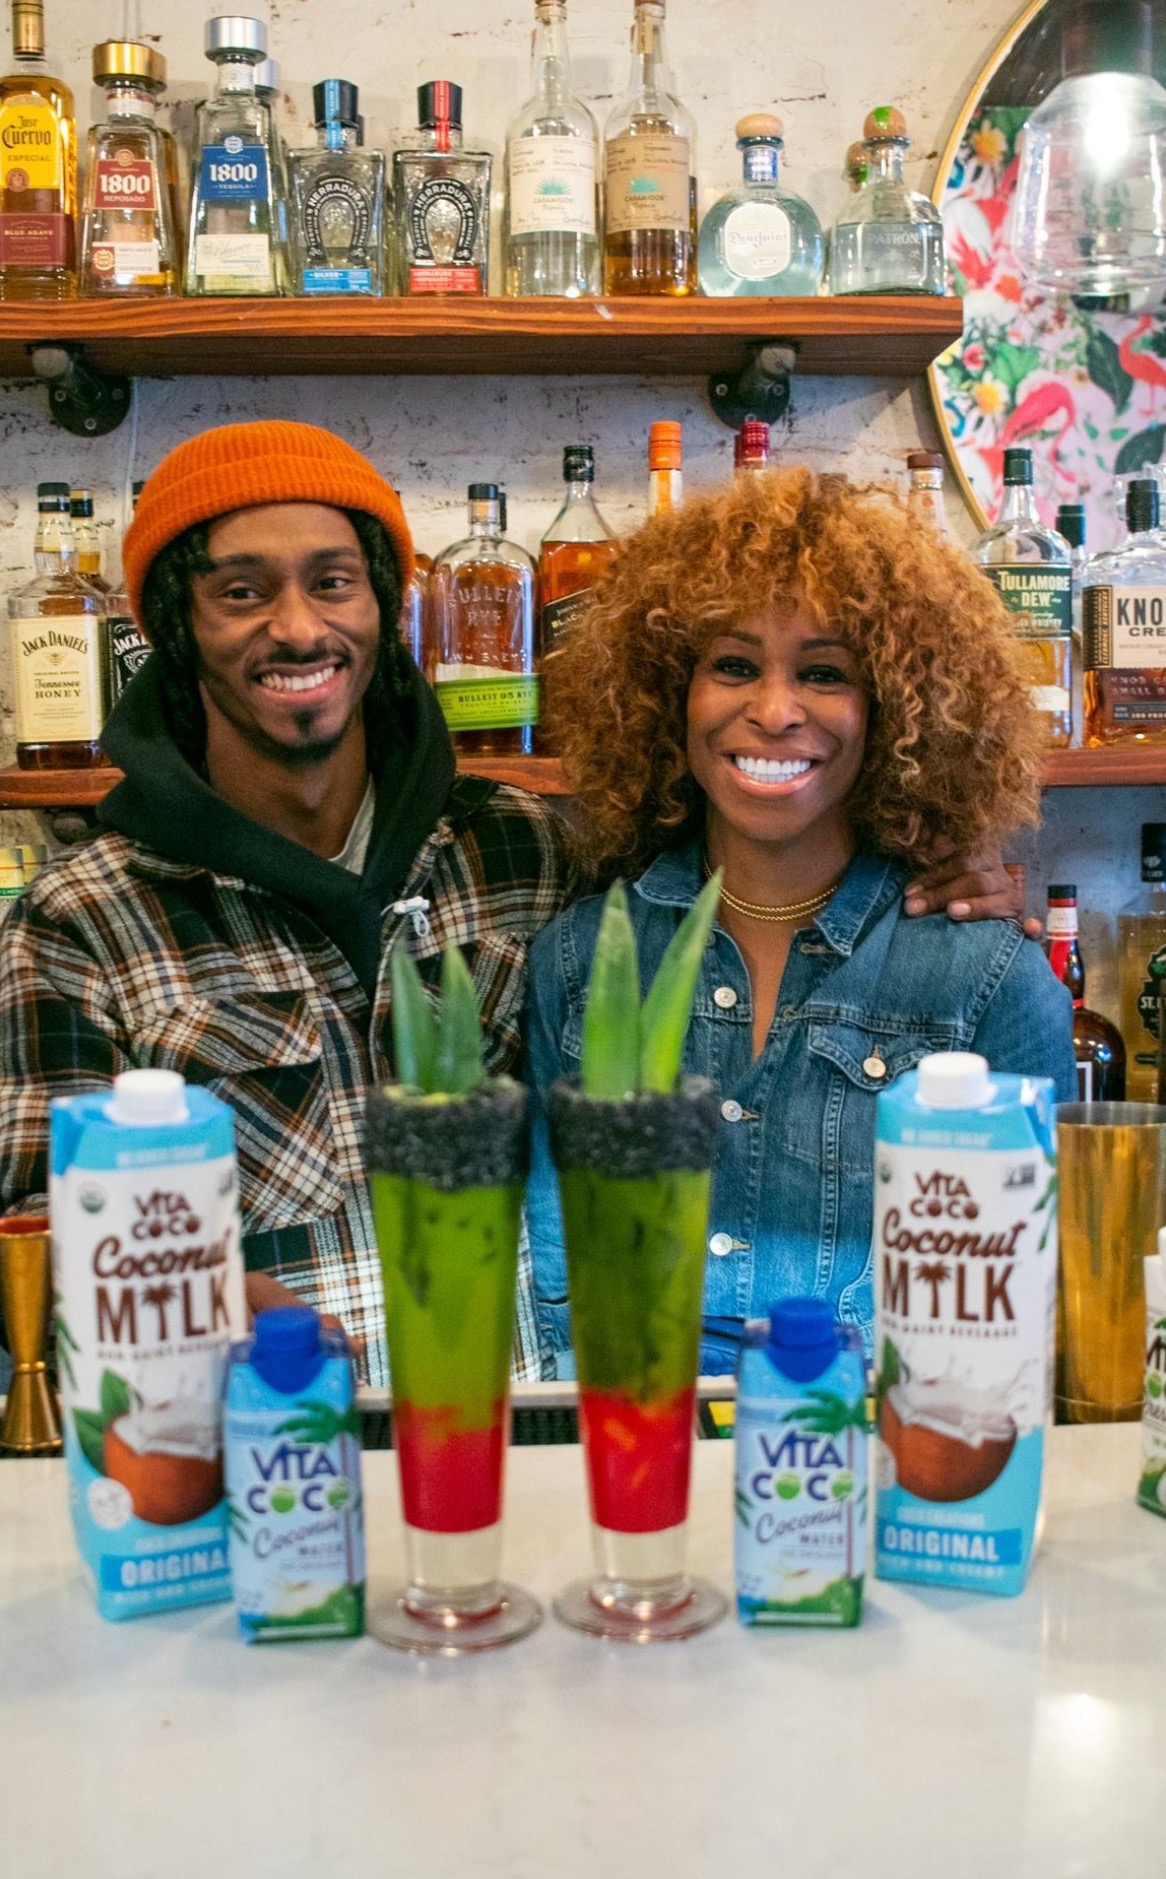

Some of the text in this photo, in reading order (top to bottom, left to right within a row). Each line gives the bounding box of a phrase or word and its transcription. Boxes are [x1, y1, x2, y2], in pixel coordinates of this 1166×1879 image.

[2, 124, 51, 149] Cuervo
[99, 174, 151, 194] 1800
[209, 163, 258, 182] 1800
[103, 195, 147, 203] REPOSADO
[307, 182, 366, 208] HERRADURA
[415, 183, 473, 211] HERRADURA
[997, 571, 1071, 592] TULLAMORE
[1021, 592, 1051, 607] DEW
[1117, 598, 1163, 626] KNO
[22, 630, 88, 657] JACK DANIEL'S
[113, 633, 141, 656] JACK
[34, 679, 80, 689] Tennessee
[35, 690, 80, 699] HONEY
[458, 692, 497, 703] BULLEIT
[500, 691, 515, 699] 95
[915, 1170, 970, 1198] VITA
[134, 1189, 190, 1217] VITA
[909, 1199, 979, 1220] COCO
[132, 1215, 200, 1241] COCO
[883, 1207, 1027, 1257] Coconut
[94, 1227, 232, 1279] Coconut
[883, 1257, 1016, 1322] MILK
[96, 1270, 231, 1345] MILK
[251, 1444, 338, 1481] VITA
[758, 1430, 845, 1469] VITA
[247, 1485, 350, 1514] COCO
[752, 1471, 854, 1501] COCO
[755, 1501, 843, 1544] Coconut
[884, 1525, 999, 1561] ORIGINAL
[120, 1548, 226, 1588] ORIGINA
